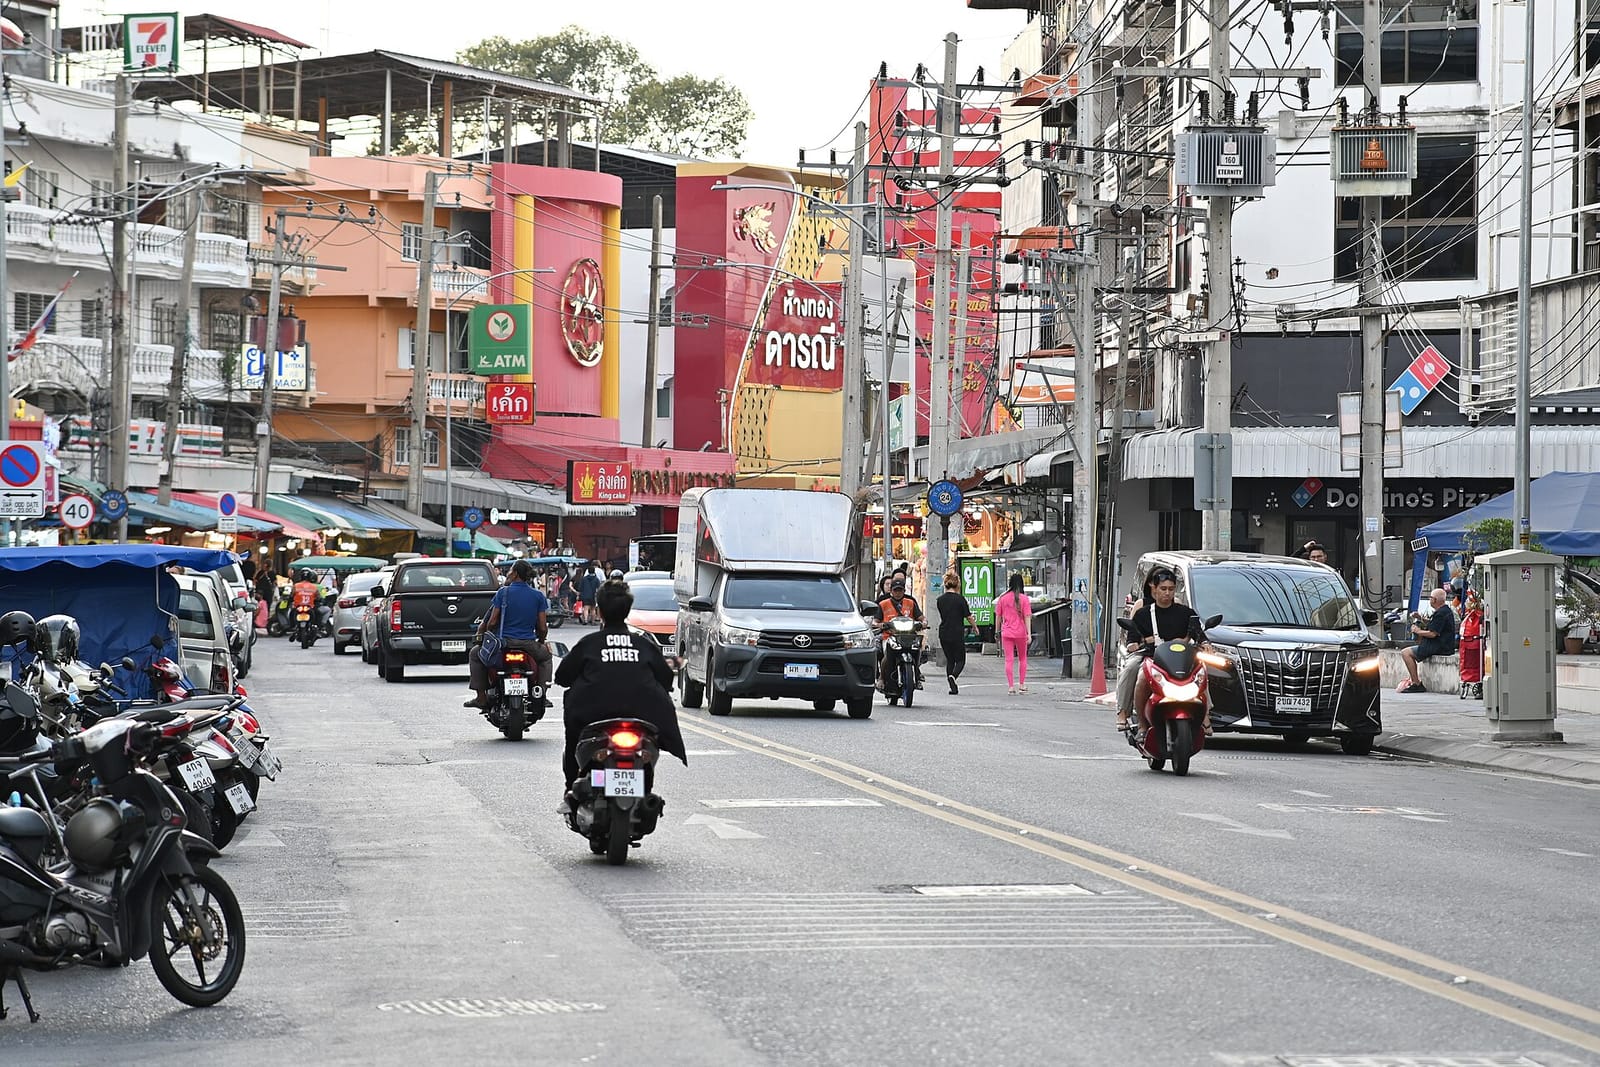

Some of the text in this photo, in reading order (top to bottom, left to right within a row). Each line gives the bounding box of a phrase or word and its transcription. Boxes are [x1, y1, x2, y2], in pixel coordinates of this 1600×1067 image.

[137, 22, 166, 66] 7
[1225, 156, 1236, 164] 160
[783, 289, 834, 319] ห้างทอง
[765, 322, 836, 371] ดารณี
[493, 354, 526, 368] ATM
[246, 378, 304, 387] PHAMACY
[492, 386, 528, 412] เค้ก
[598, 464, 627, 490] คิงเค้ก
[598, 491, 626, 500] King cake
[940, 494, 950, 502] 24
[1327, 487, 1501, 508] Doino's Pizz
[65, 503, 89, 519] 40
[963, 565, 992, 595] ยา
[965, 596, 992, 608] HARMACY
[606, 634, 633, 648] COOL
[601, 648, 640, 663] STREET
[192, 776, 213, 791] 4040
[614, 787, 635, 795] 954
